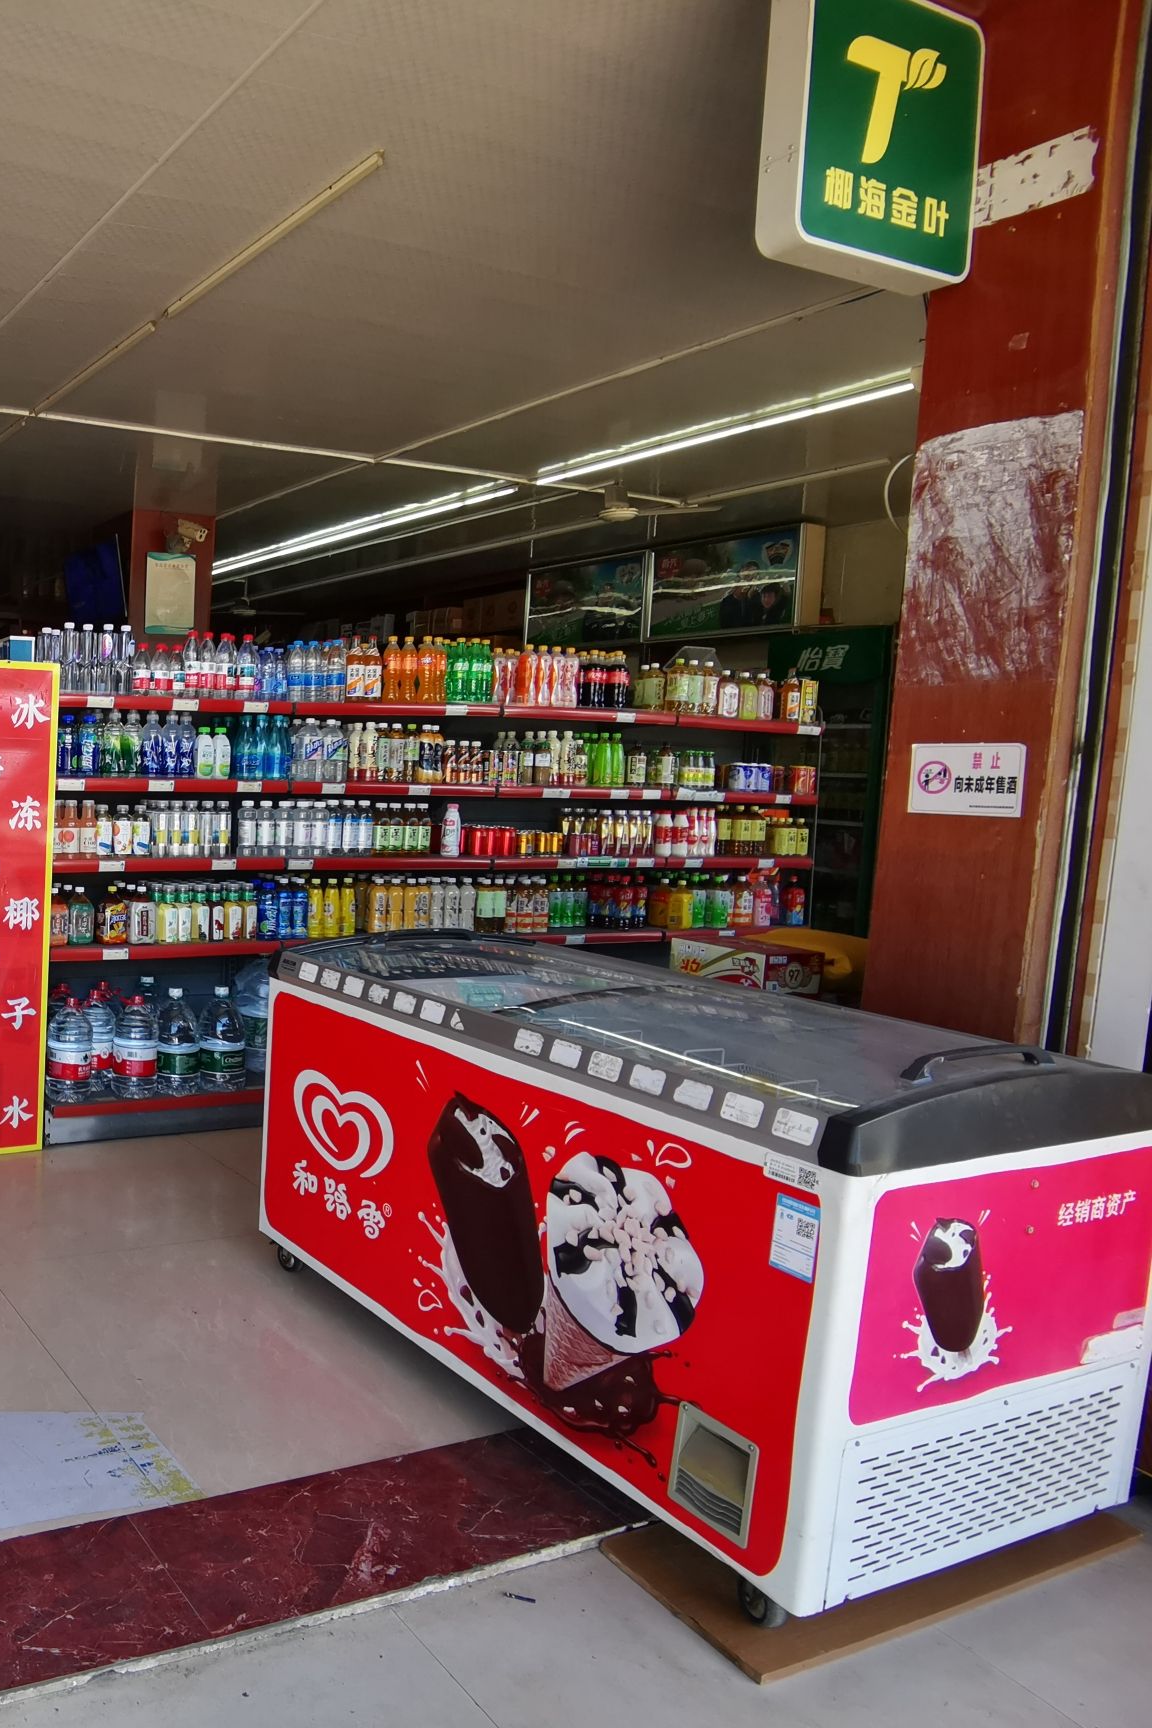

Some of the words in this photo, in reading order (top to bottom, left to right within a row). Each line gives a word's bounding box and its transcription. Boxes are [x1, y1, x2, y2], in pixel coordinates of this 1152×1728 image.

[823, 166, 949, 238] 椰海金叶
[972, 752, 1001, 770] 禁止
[953, 775, 1018, 795] 向未成年售酒
[0, 694, 51, 1129] 冰冻椰子水
[1056, 1190, 1137, 1227] 经销商资产
